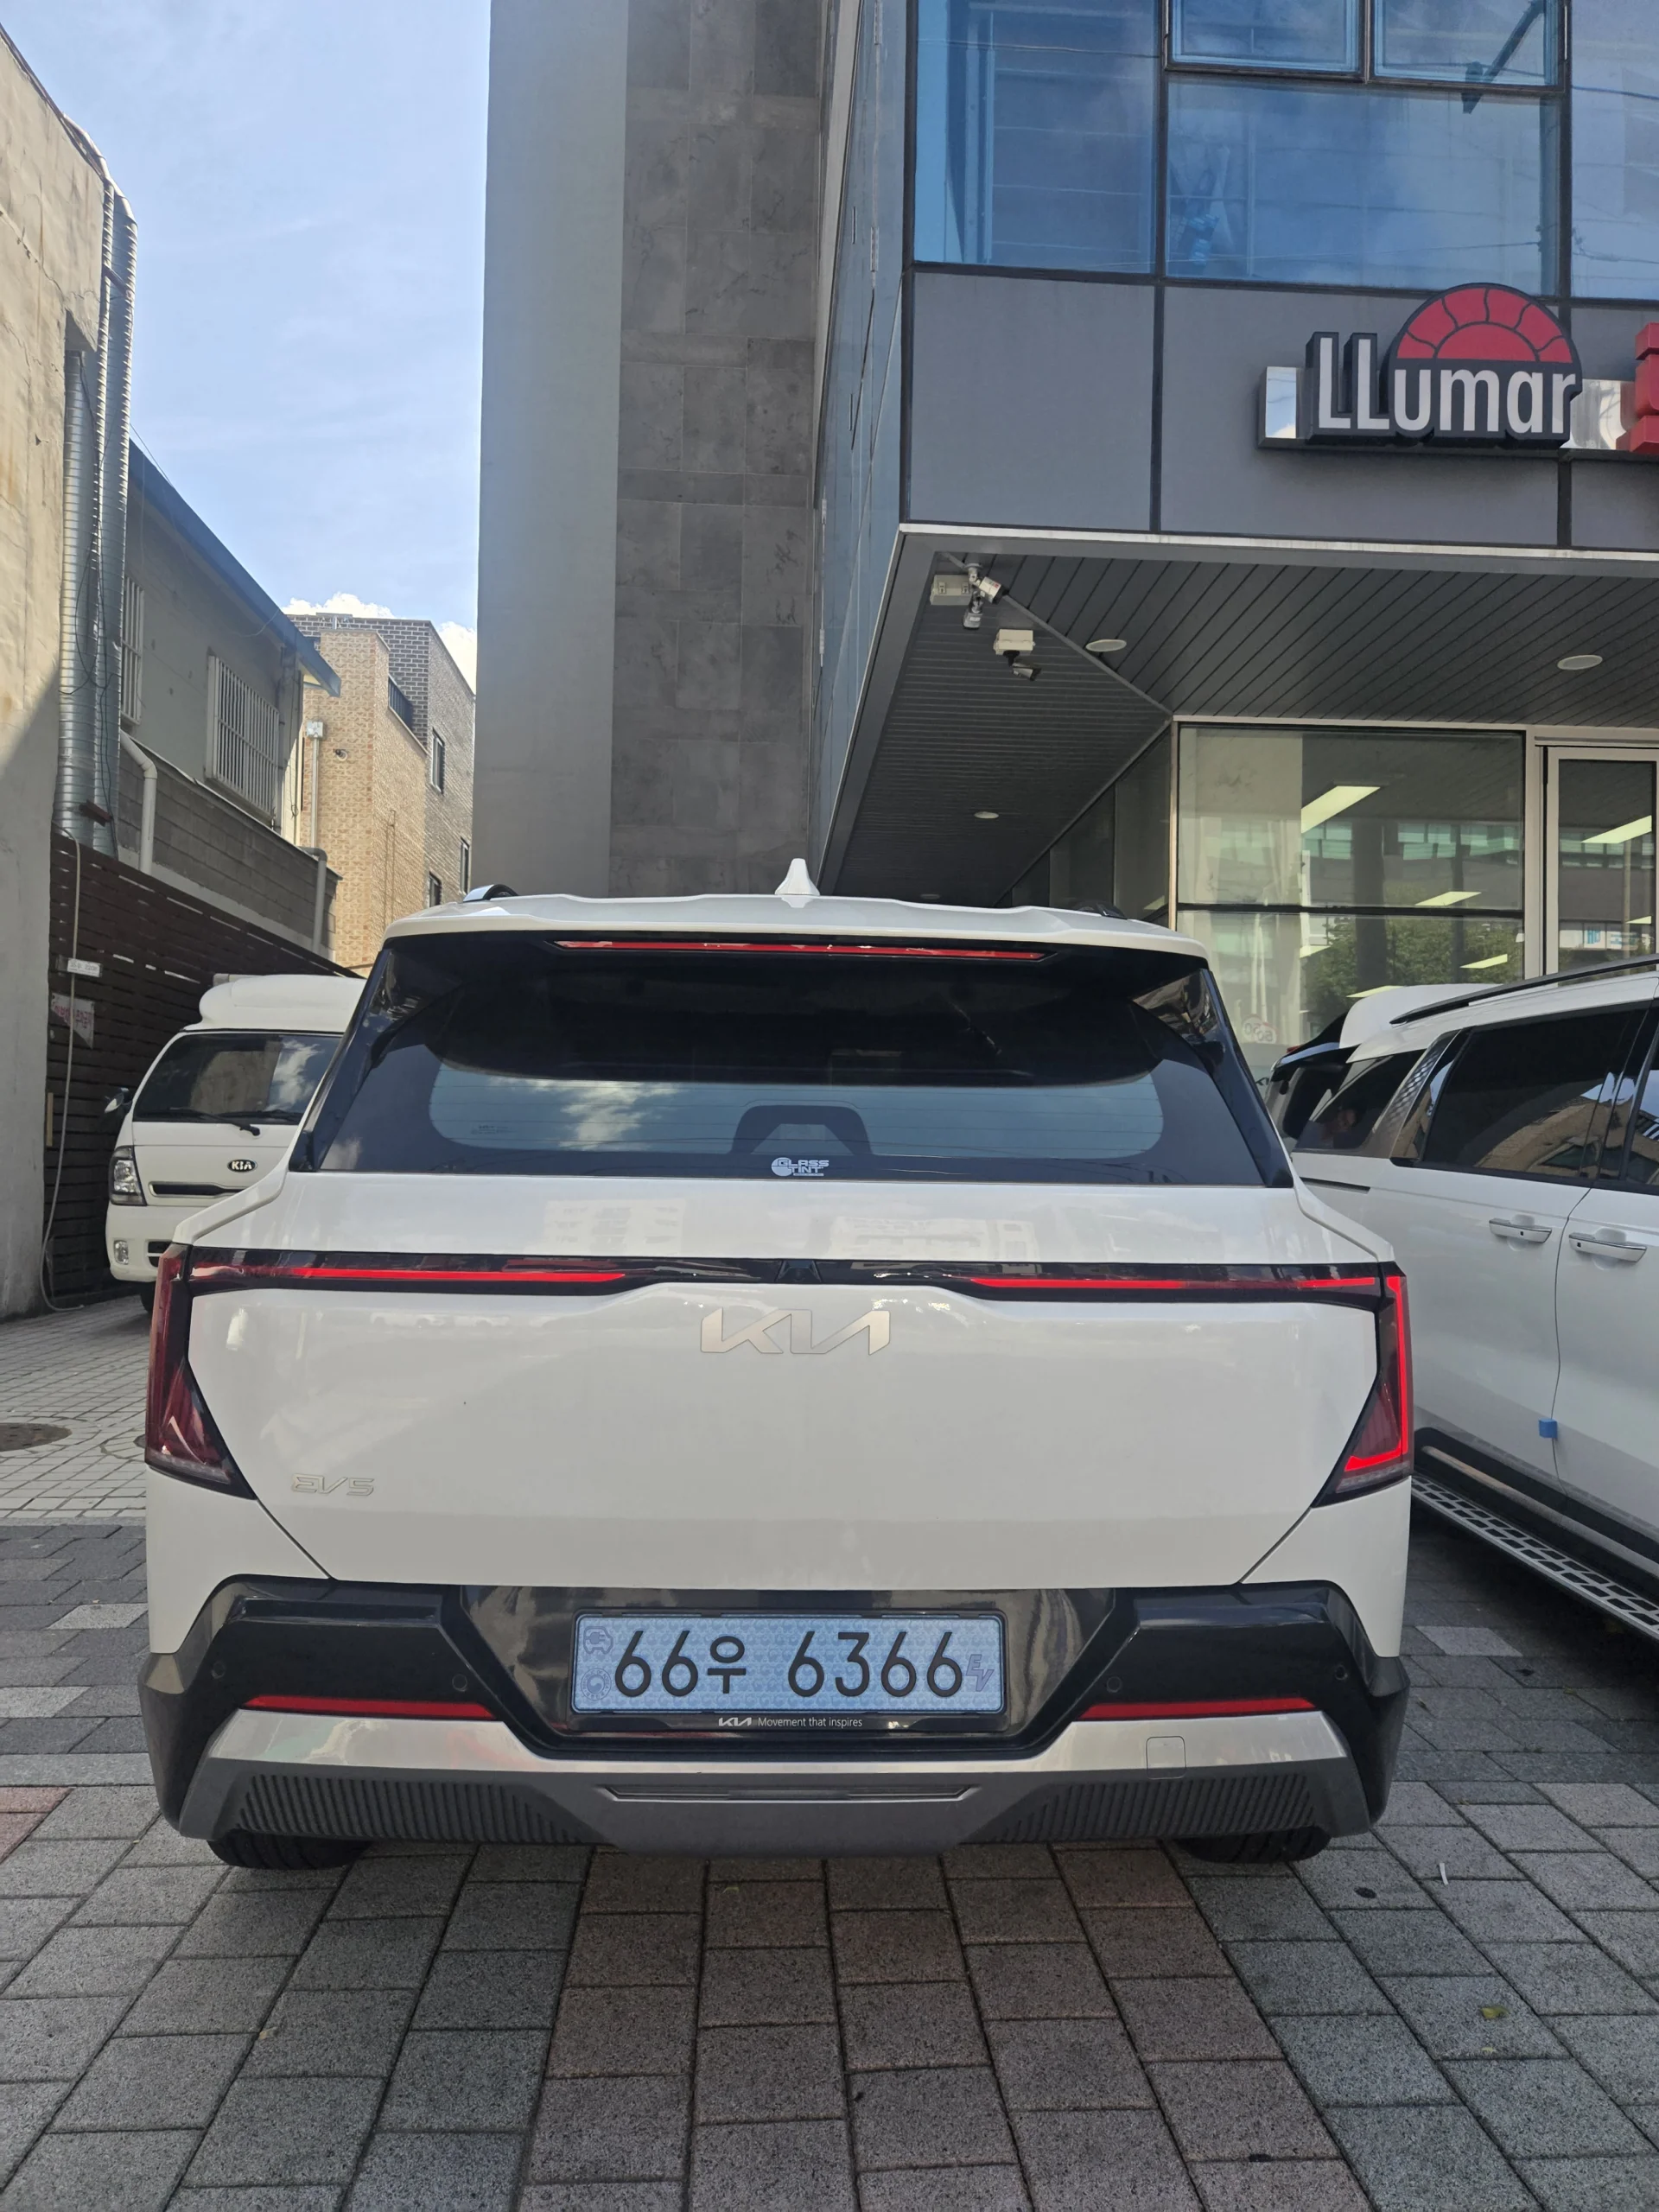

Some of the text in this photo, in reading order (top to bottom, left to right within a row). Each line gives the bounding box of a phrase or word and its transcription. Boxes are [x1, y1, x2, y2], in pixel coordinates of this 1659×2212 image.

[1318, 337, 1576, 434] LLumar
[231, 1160, 252, 1170] KIA
[700, 1306, 891, 1356] KIA
[614, 1630, 747, 1697] 66우
[787, 1630, 963, 1698] 6366
[966, 1654, 995, 1692] EV
[718, 1717, 863, 1729] KIA Movement that inspires
